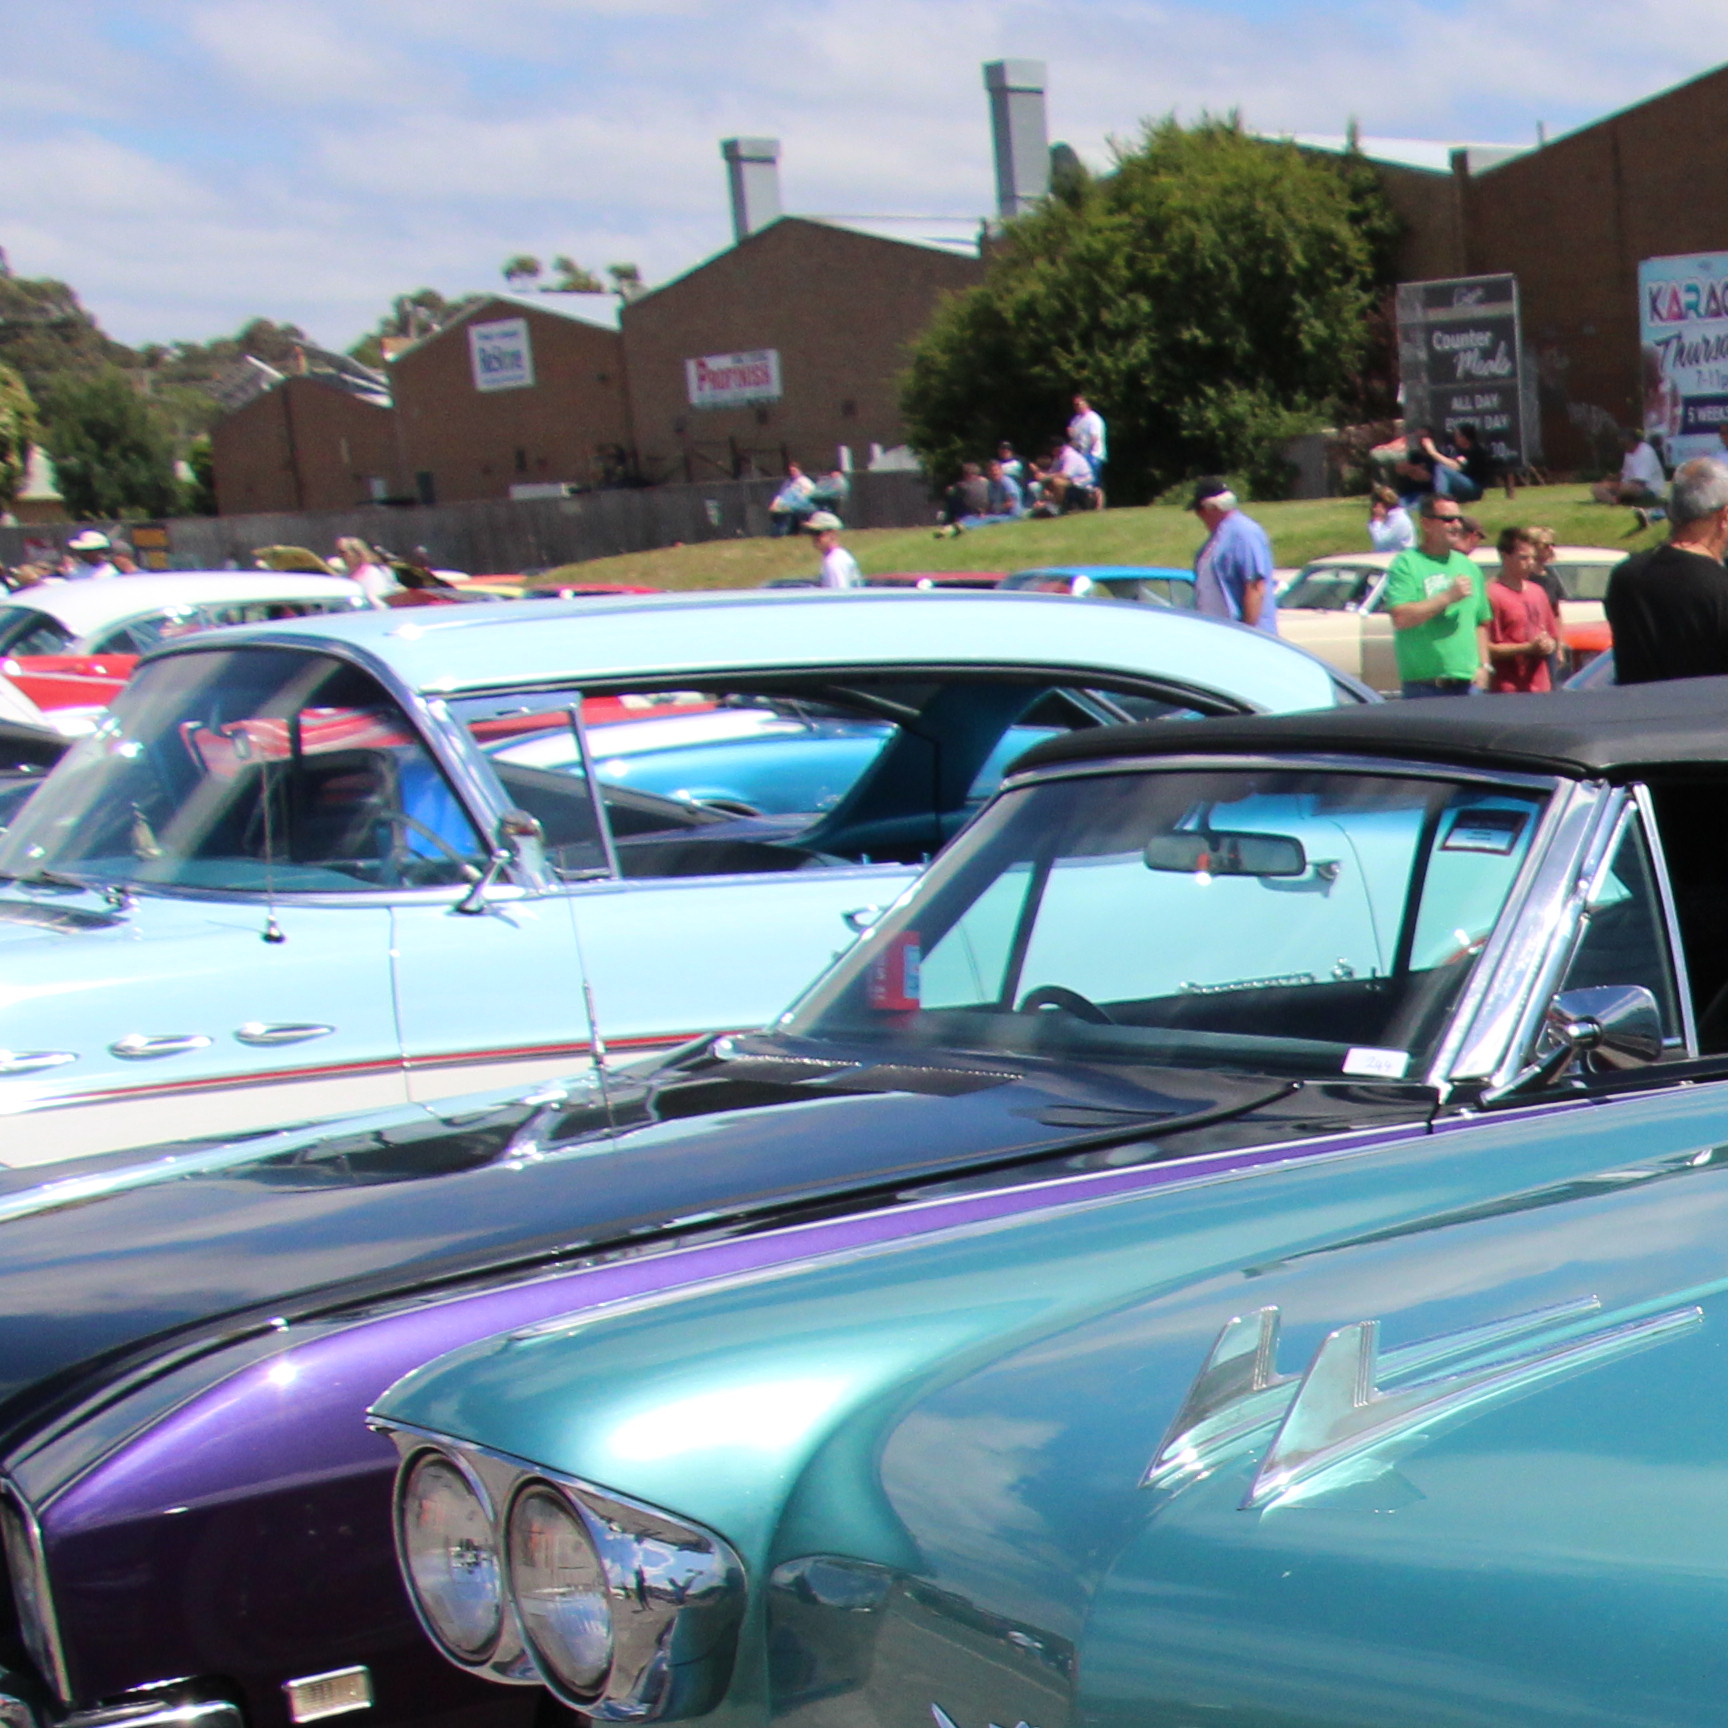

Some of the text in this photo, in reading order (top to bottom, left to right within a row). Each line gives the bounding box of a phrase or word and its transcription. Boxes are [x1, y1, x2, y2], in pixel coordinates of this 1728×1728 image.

[1432, 329, 1492, 350] Counter
[1453, 340, 1512, 380] Meals
[1475, 392, 1498, 409] DAY
